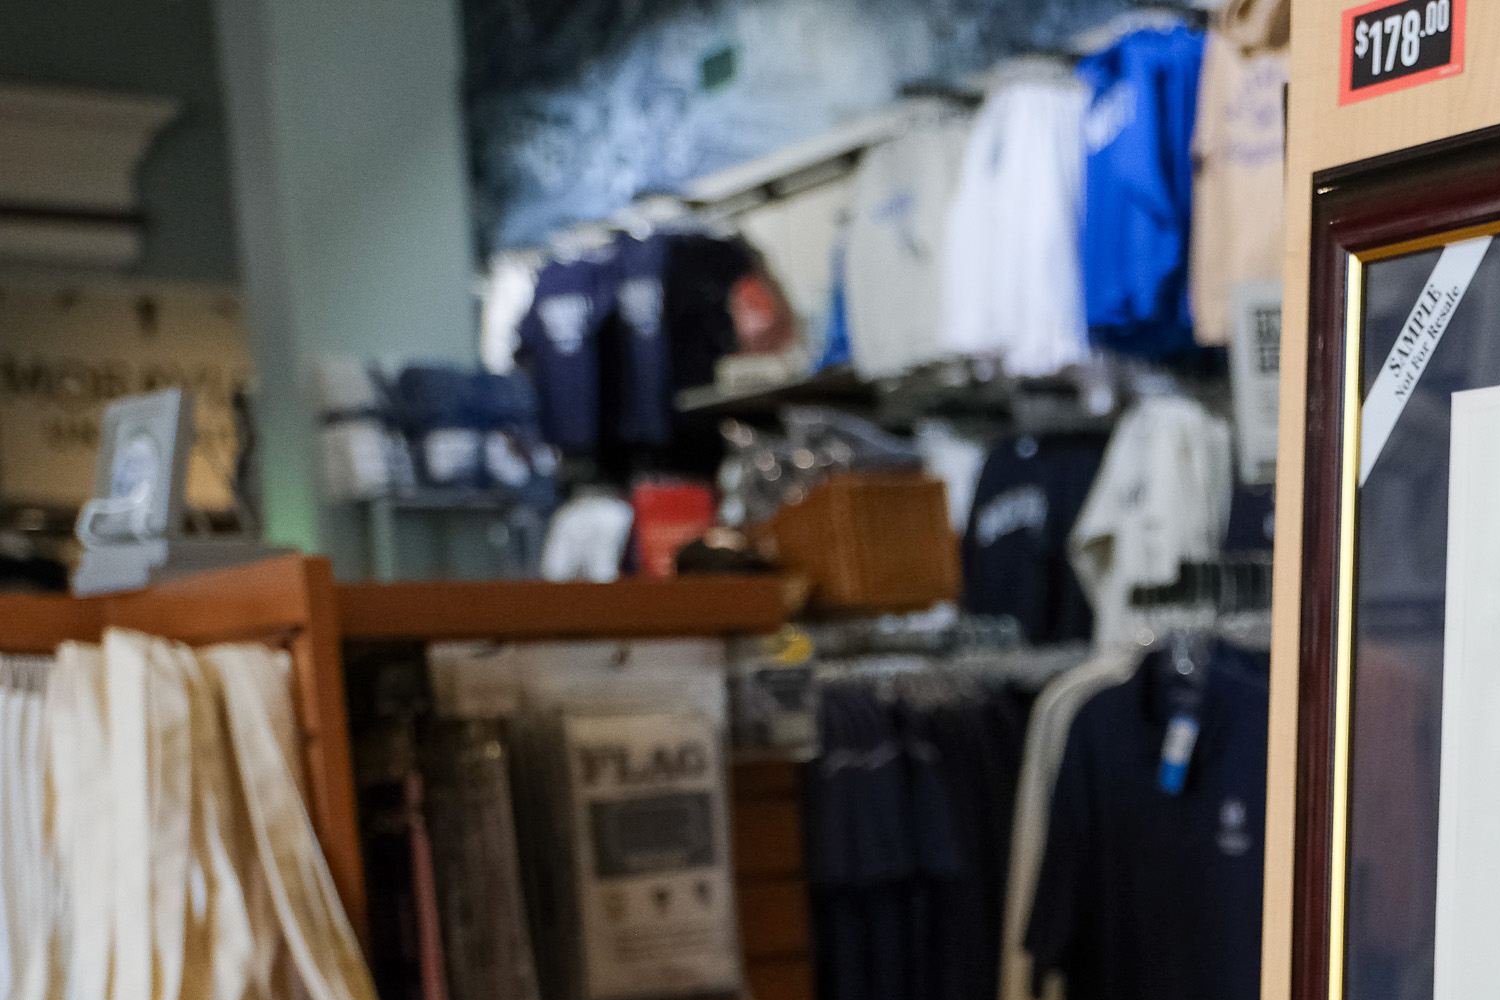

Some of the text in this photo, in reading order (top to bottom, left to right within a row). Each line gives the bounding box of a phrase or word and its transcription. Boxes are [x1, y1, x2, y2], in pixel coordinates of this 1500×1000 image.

[1355, 0, 1450, 76] $178.00
[1389, 284, 1442, 378] SAMPLE
[1394, 286, 1460, 400] Not For Resale
